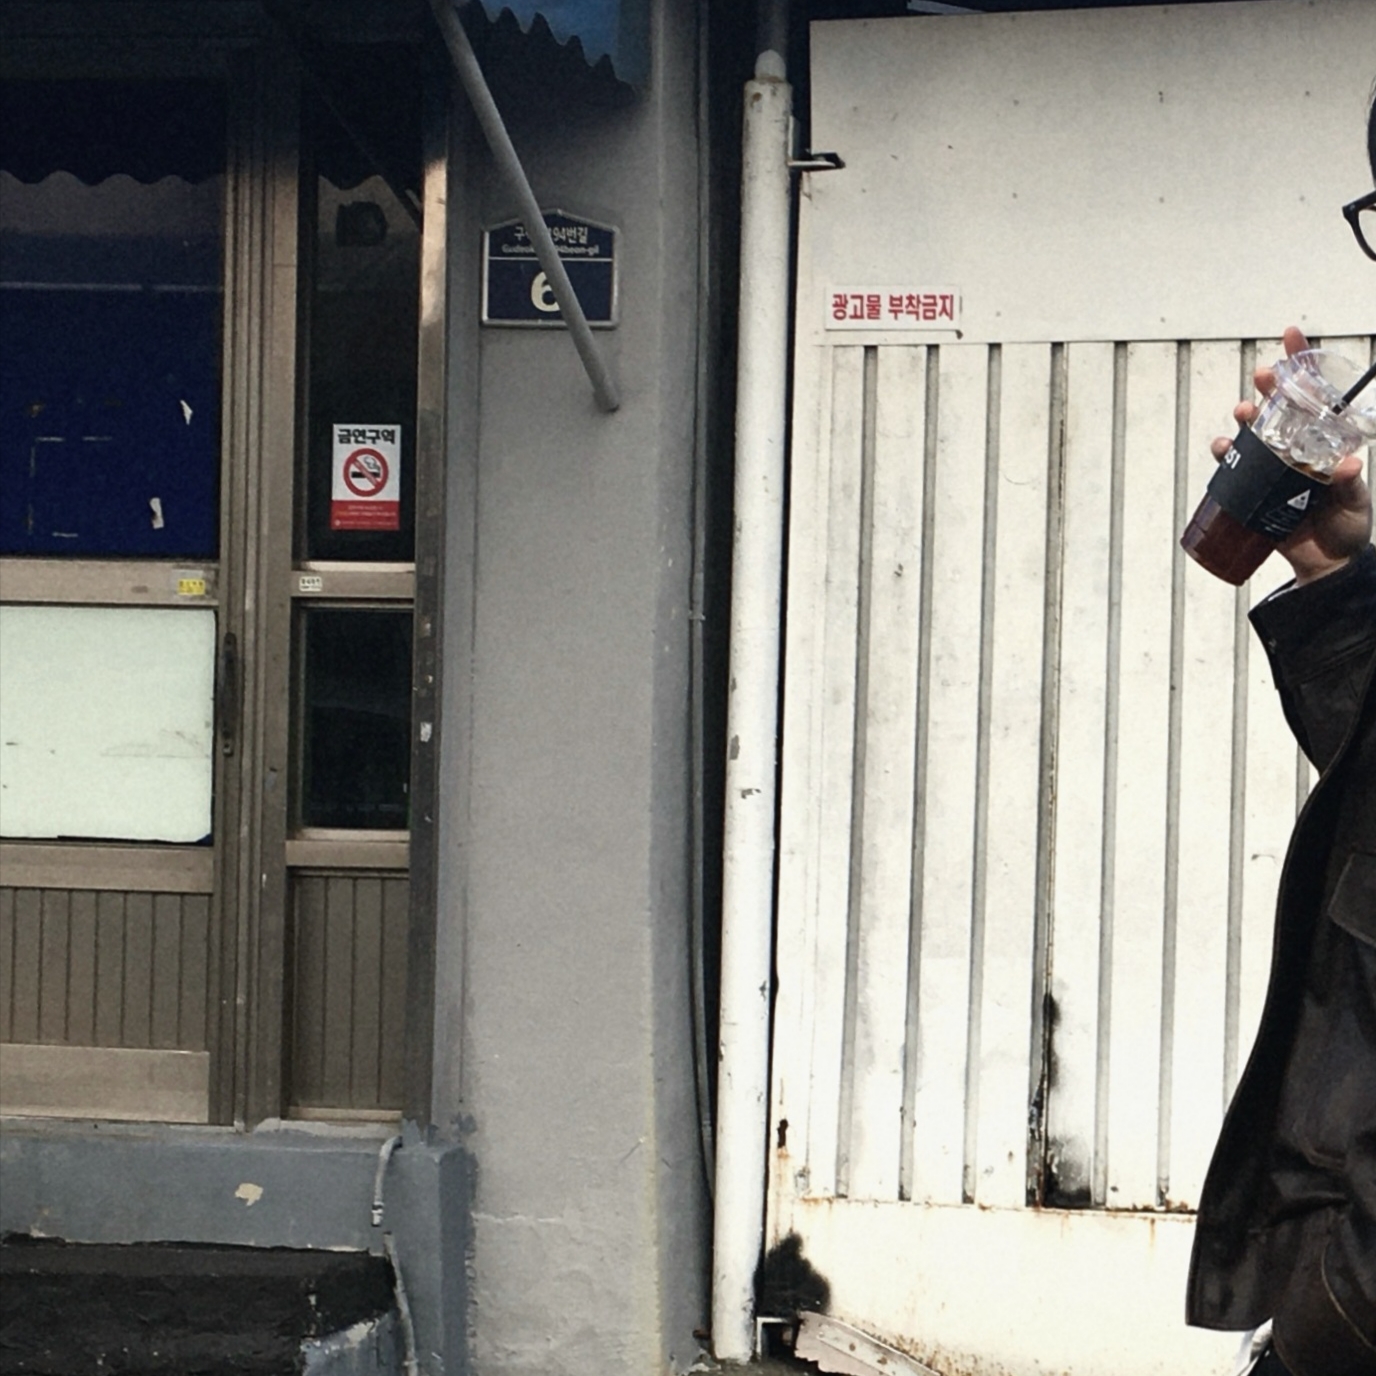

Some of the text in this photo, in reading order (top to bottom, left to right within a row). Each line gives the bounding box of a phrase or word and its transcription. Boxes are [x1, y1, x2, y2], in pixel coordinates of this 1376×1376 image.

[531, 271, 560, 312] 6
[832, 294, 954, 321] 광고물 부착금지
[338, 428, 396, 445] 금연구역
